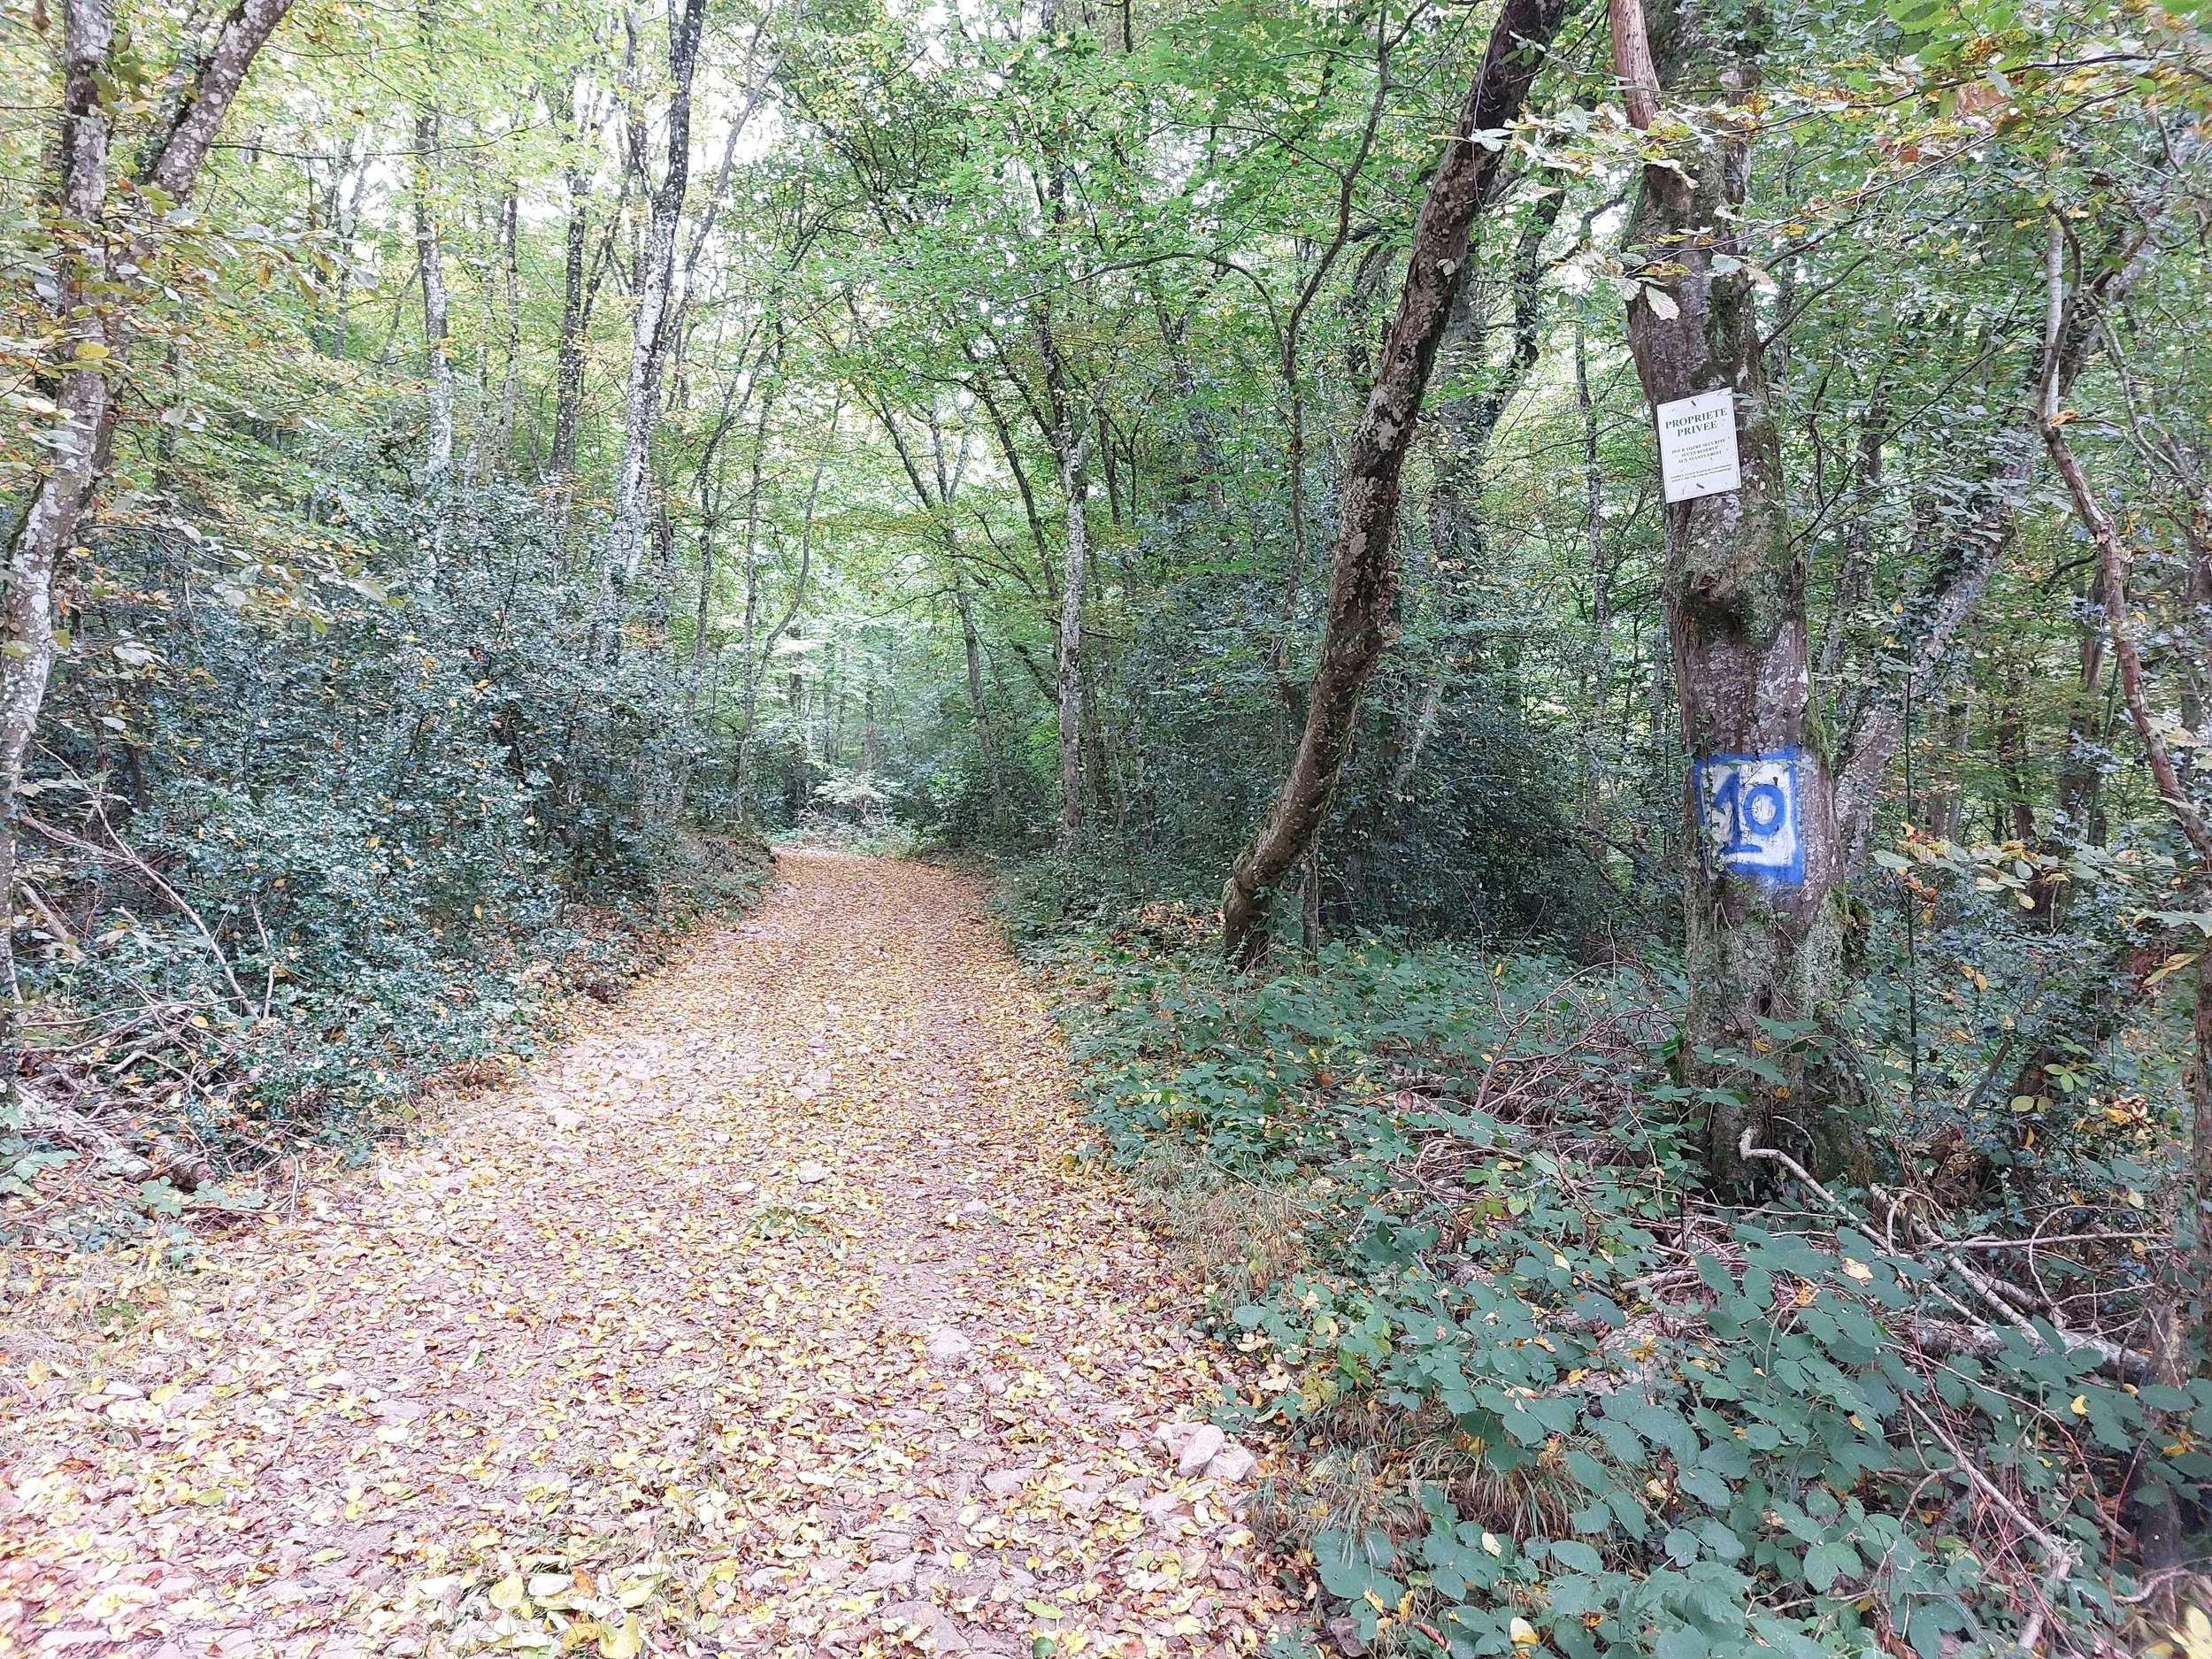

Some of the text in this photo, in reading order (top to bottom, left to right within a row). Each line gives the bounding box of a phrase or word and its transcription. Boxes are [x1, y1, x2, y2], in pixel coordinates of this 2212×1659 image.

[1665, 407, 1728, 429] PROPRIETE
[1678, 420, 1717, 437] PRIVEE
[1714, 773, 1786, 855] 10
